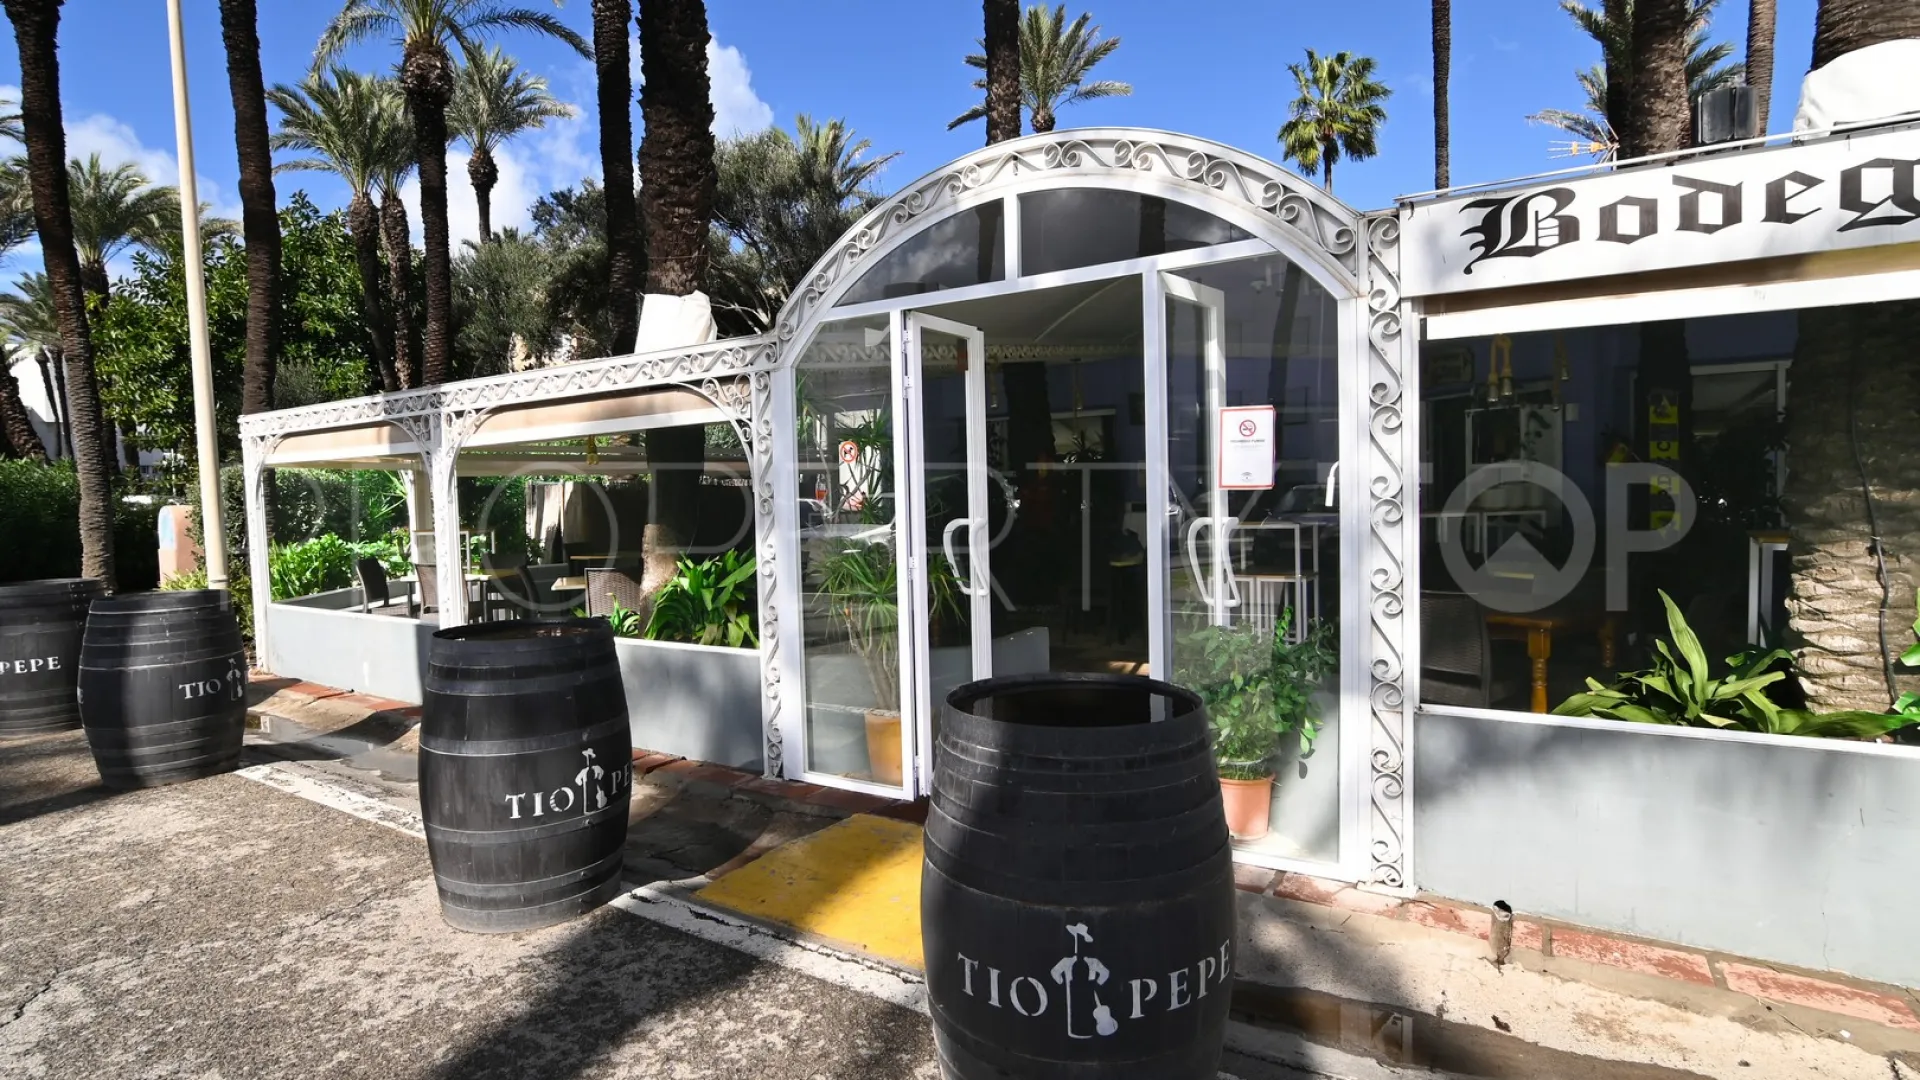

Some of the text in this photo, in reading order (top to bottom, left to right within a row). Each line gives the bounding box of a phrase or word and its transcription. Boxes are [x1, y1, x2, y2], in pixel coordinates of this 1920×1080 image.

[0, 656, 61, 675] PEPE
[178, 678, 222, 700] TIO
[504, 786, 575, 819] TIO
[957, 938, 1231, 1019] TIO PEPE
